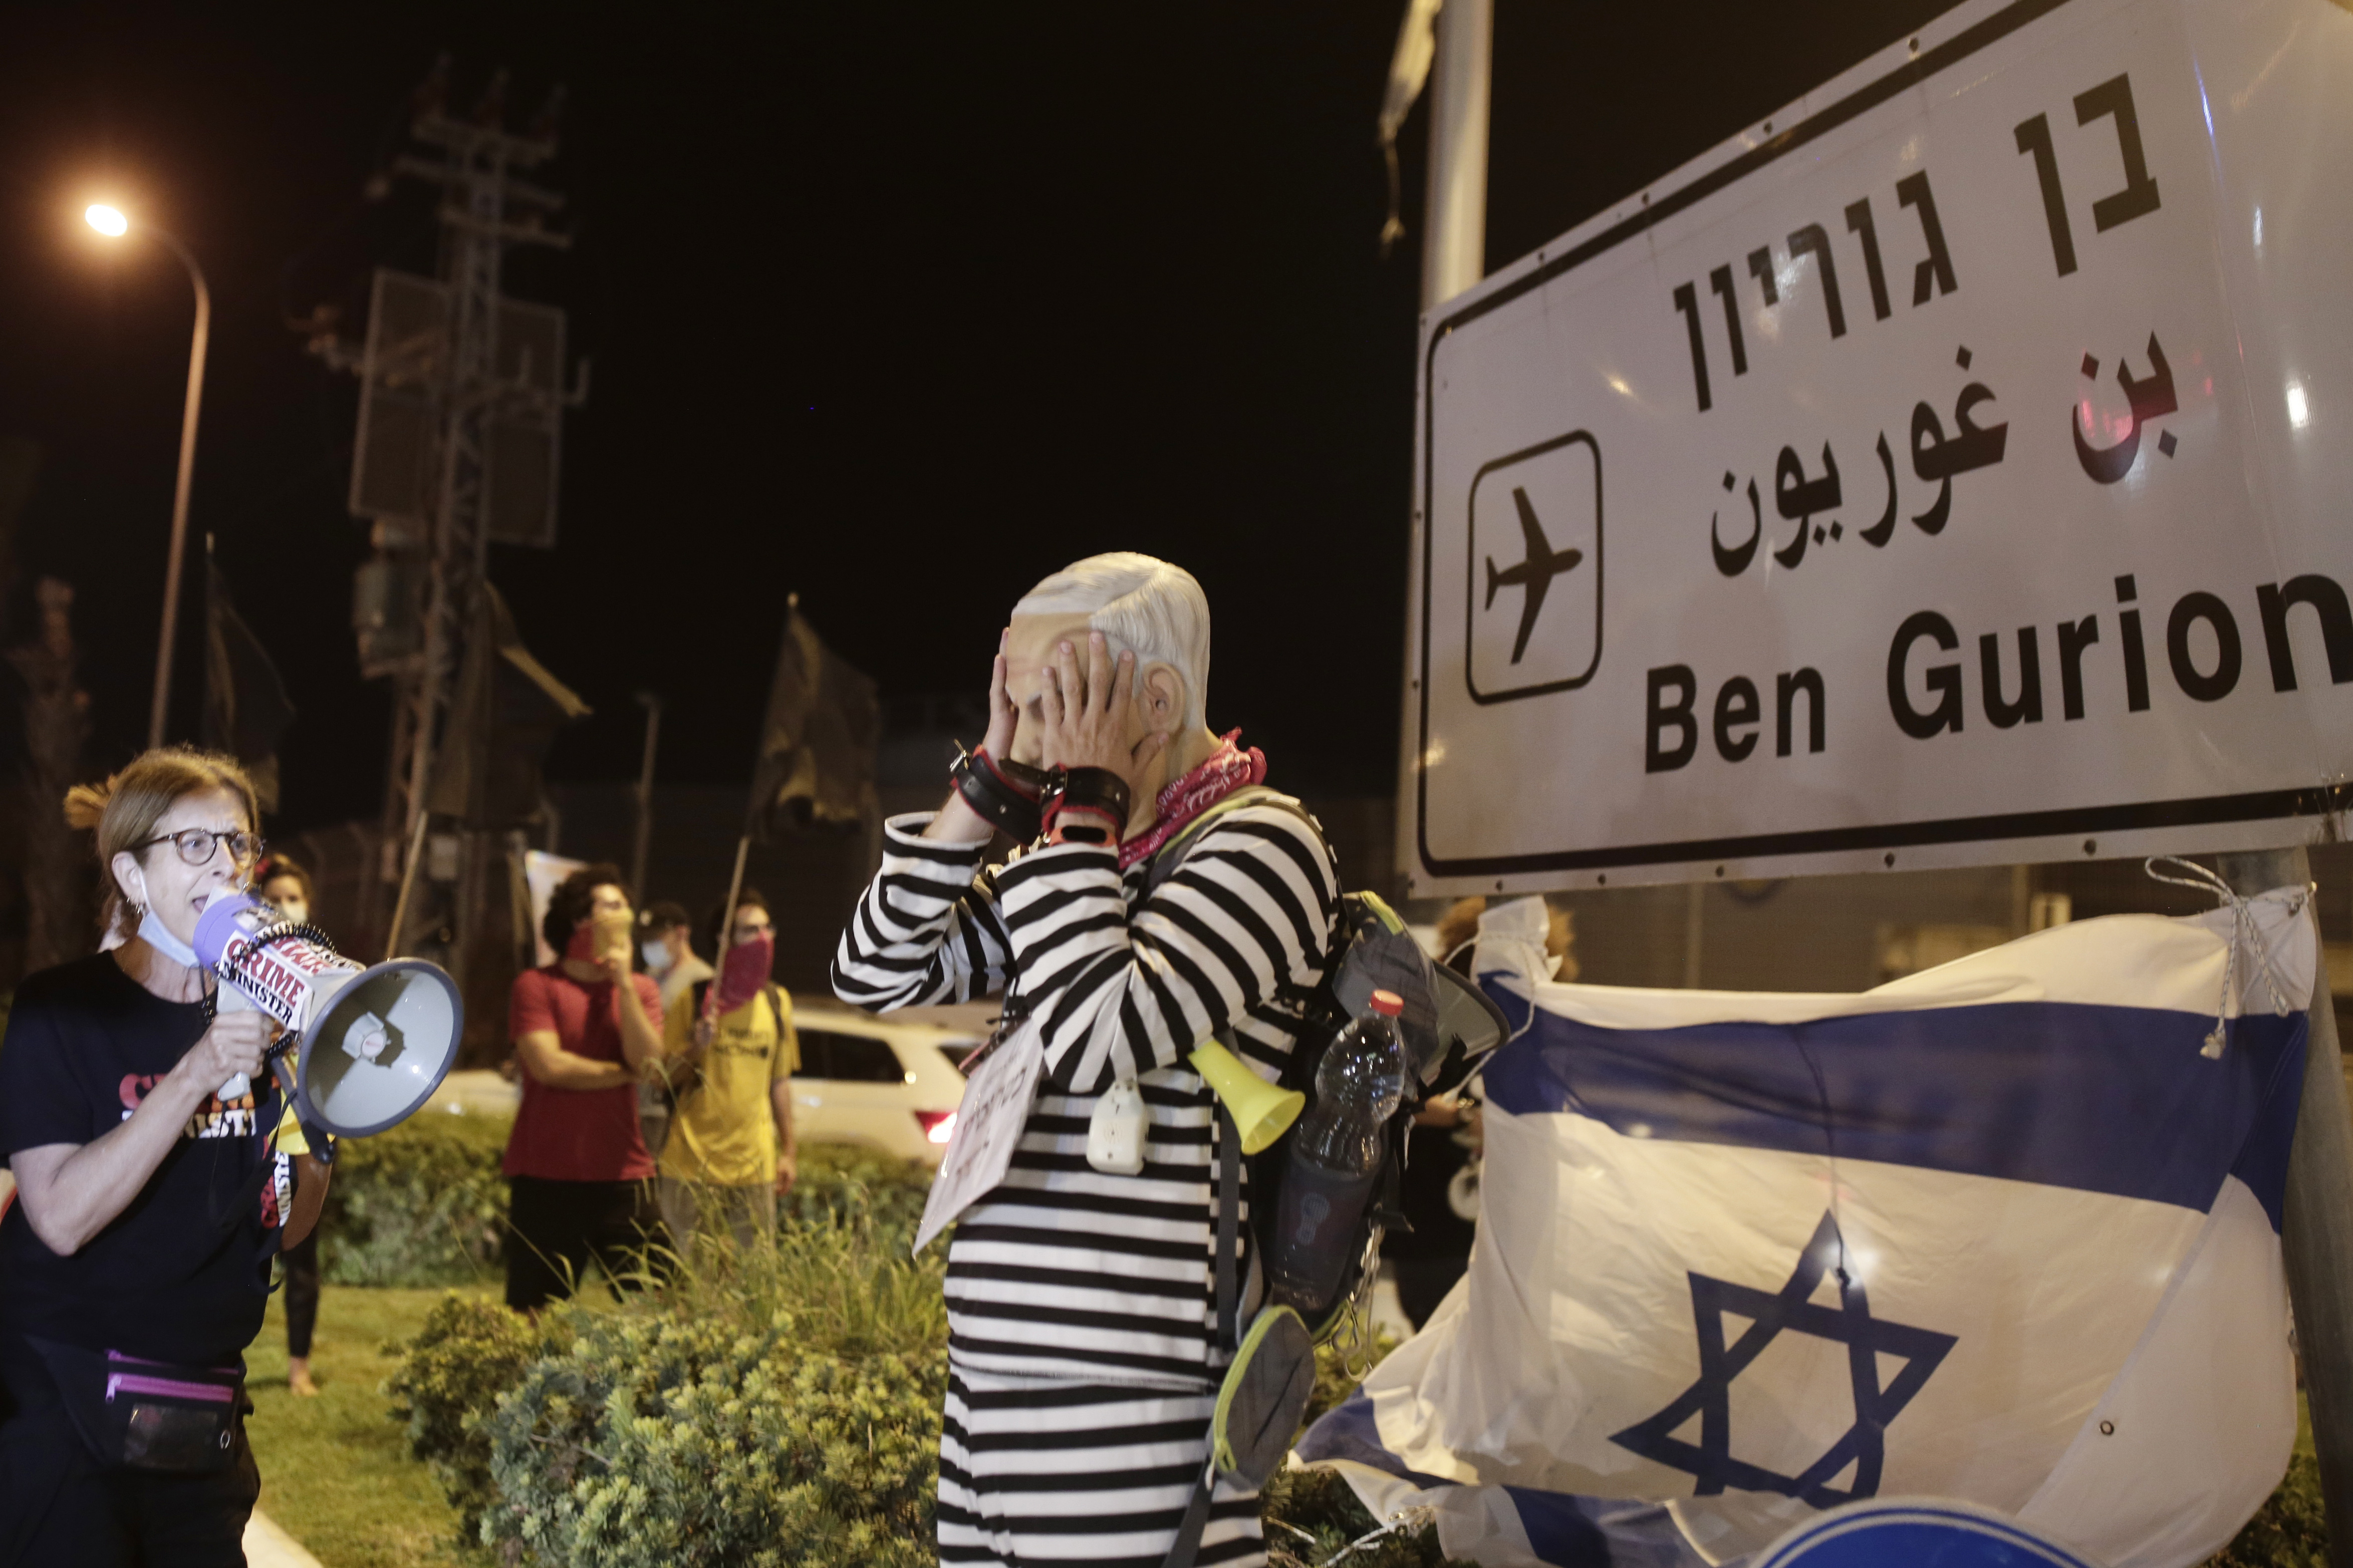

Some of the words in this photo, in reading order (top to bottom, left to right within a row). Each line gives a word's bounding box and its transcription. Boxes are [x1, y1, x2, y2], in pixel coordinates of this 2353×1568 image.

[2014, 74, 2160, 276] בן
[1674, 171, 1957, 412] גוריון
[1711, 346, 2008, 576] غوريون
[2072, 332, 2177, 484] بن
[1646, 665, 1825, 774] Ben
[1887, 574, 2353, 739] Gurion
[227, 939, 305, 1008] CRIME
